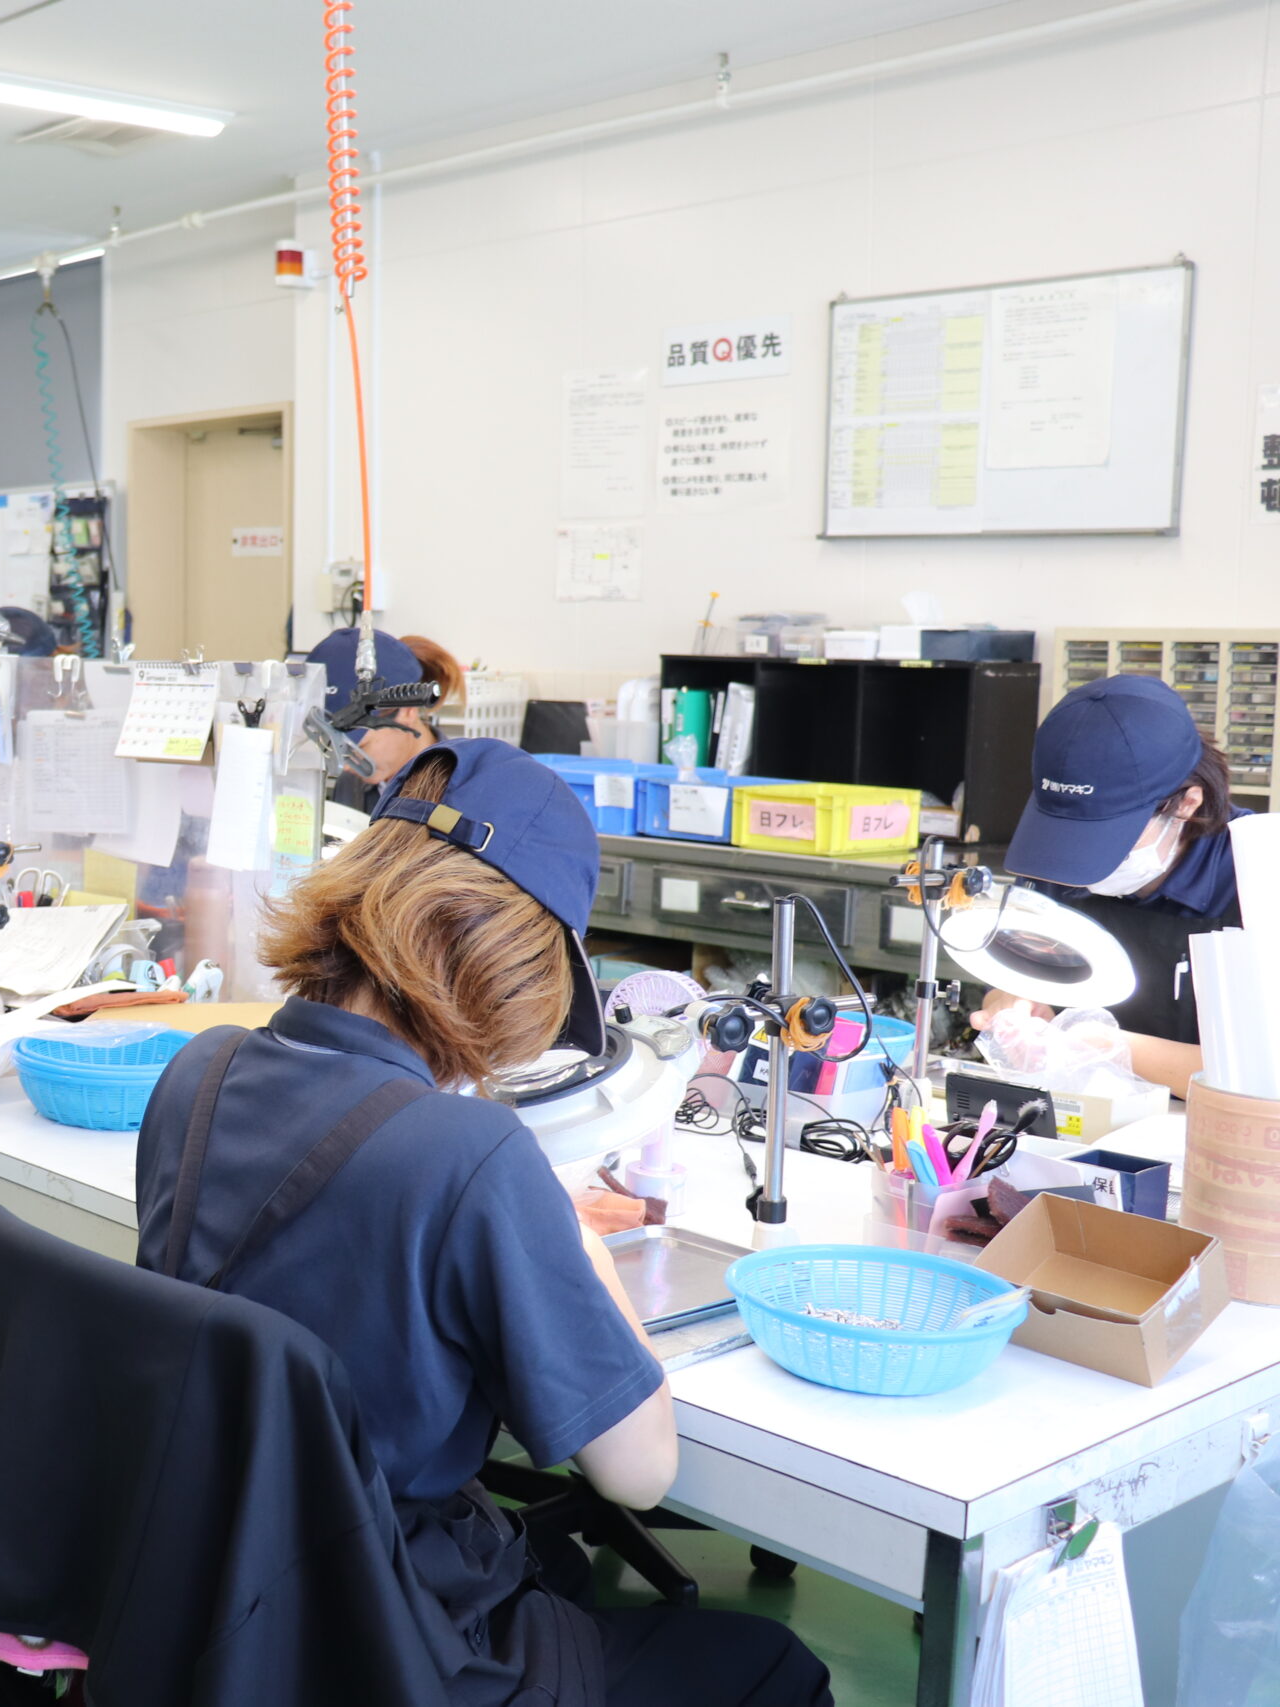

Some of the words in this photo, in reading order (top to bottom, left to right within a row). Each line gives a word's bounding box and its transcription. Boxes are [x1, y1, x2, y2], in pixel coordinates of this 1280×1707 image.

[667, 332, 782, 368] 品質Q優先
[138, 670, 145, 681] 9
